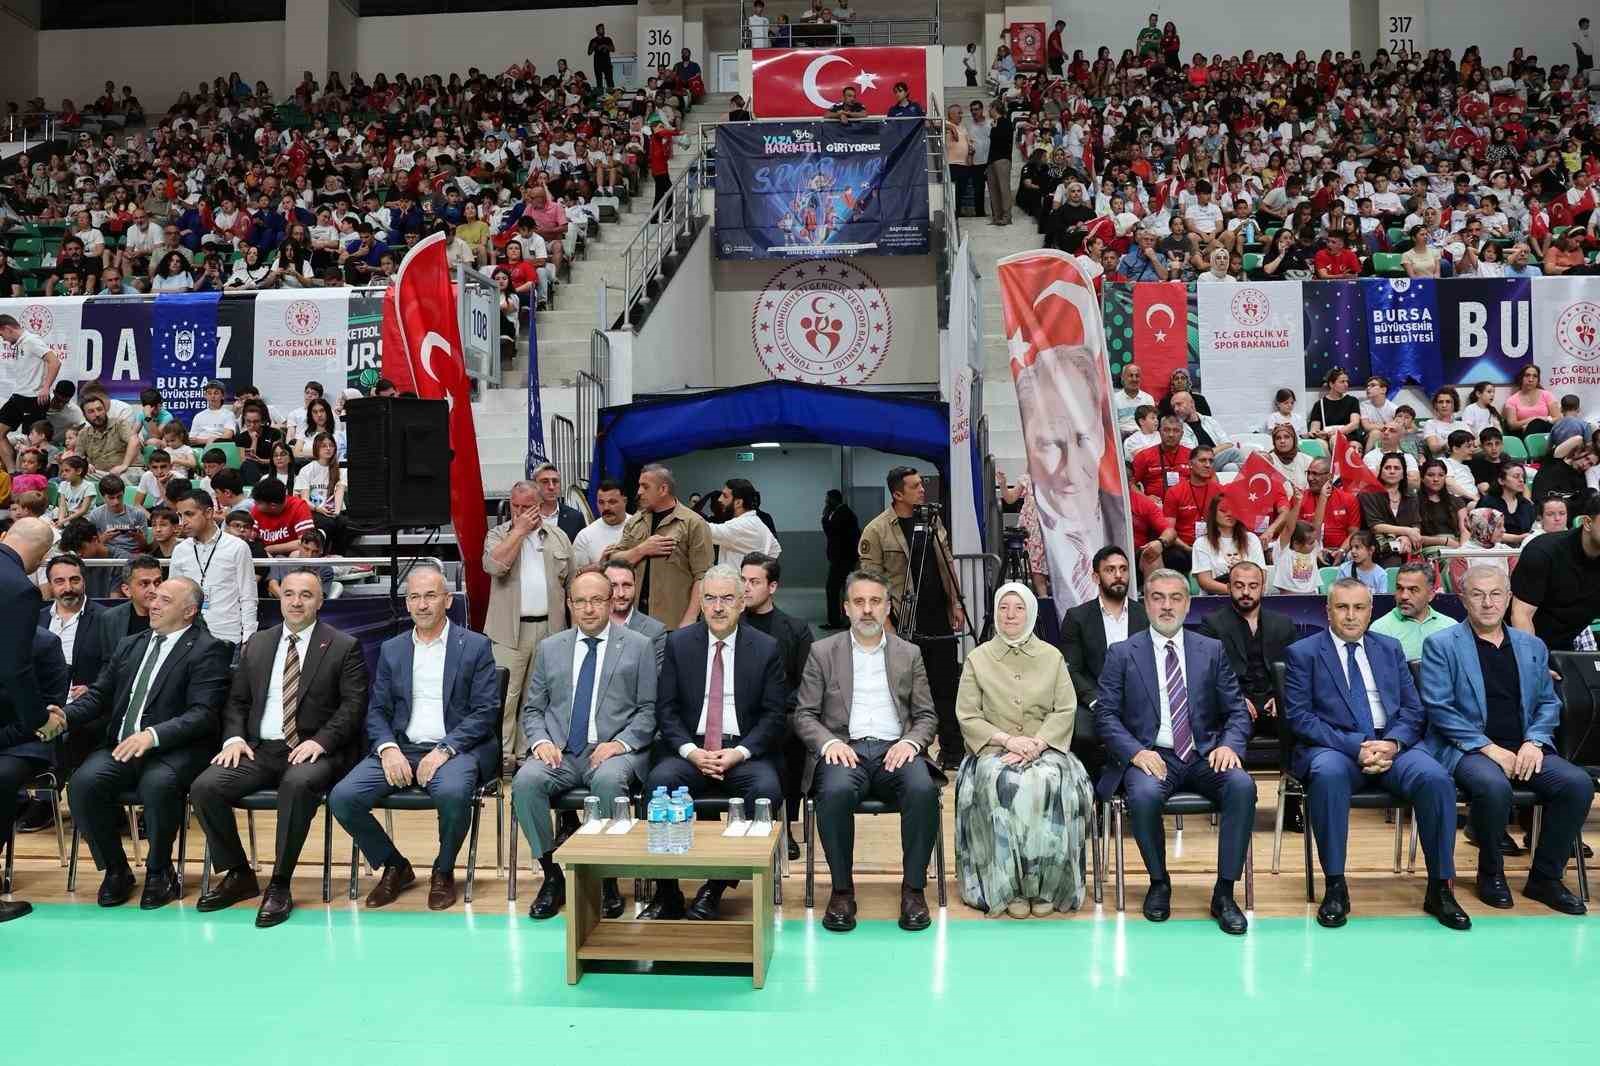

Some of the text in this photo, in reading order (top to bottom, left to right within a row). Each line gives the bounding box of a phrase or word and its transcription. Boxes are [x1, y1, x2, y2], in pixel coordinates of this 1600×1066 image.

[1389, 16, 1413, 33] 317
[648, 29, 672, 46] 316
[647, 51, 671, 68] 210
[1373, 307, 1432, 323] BURSA
[472, 308, 488, 341] 108
[1374, 321, 1433, 333] BÜYÜKŞEHİR
[1458, 300, 1529, 359] BU
[1214, 329, 1289, 340] T.C. GENÇLİK VE
[1375, 332, 1434, 345] BELEDİYESİ
[286, 337, 323, 348] GENÇLİK
[325, 338, 336, 346] VE
[1214, 339, 1289, 350] SPOR BAKANLIĞI
[268, 349, 290, 357] SPOR
[156, 376, 209, 389] BURSA
[1550, 376, 1576, 386] SPOR
[160, 388, 207, 400] ÜYÜKŞEHİ
[161, 400, 209, 410] ELEDİYES
